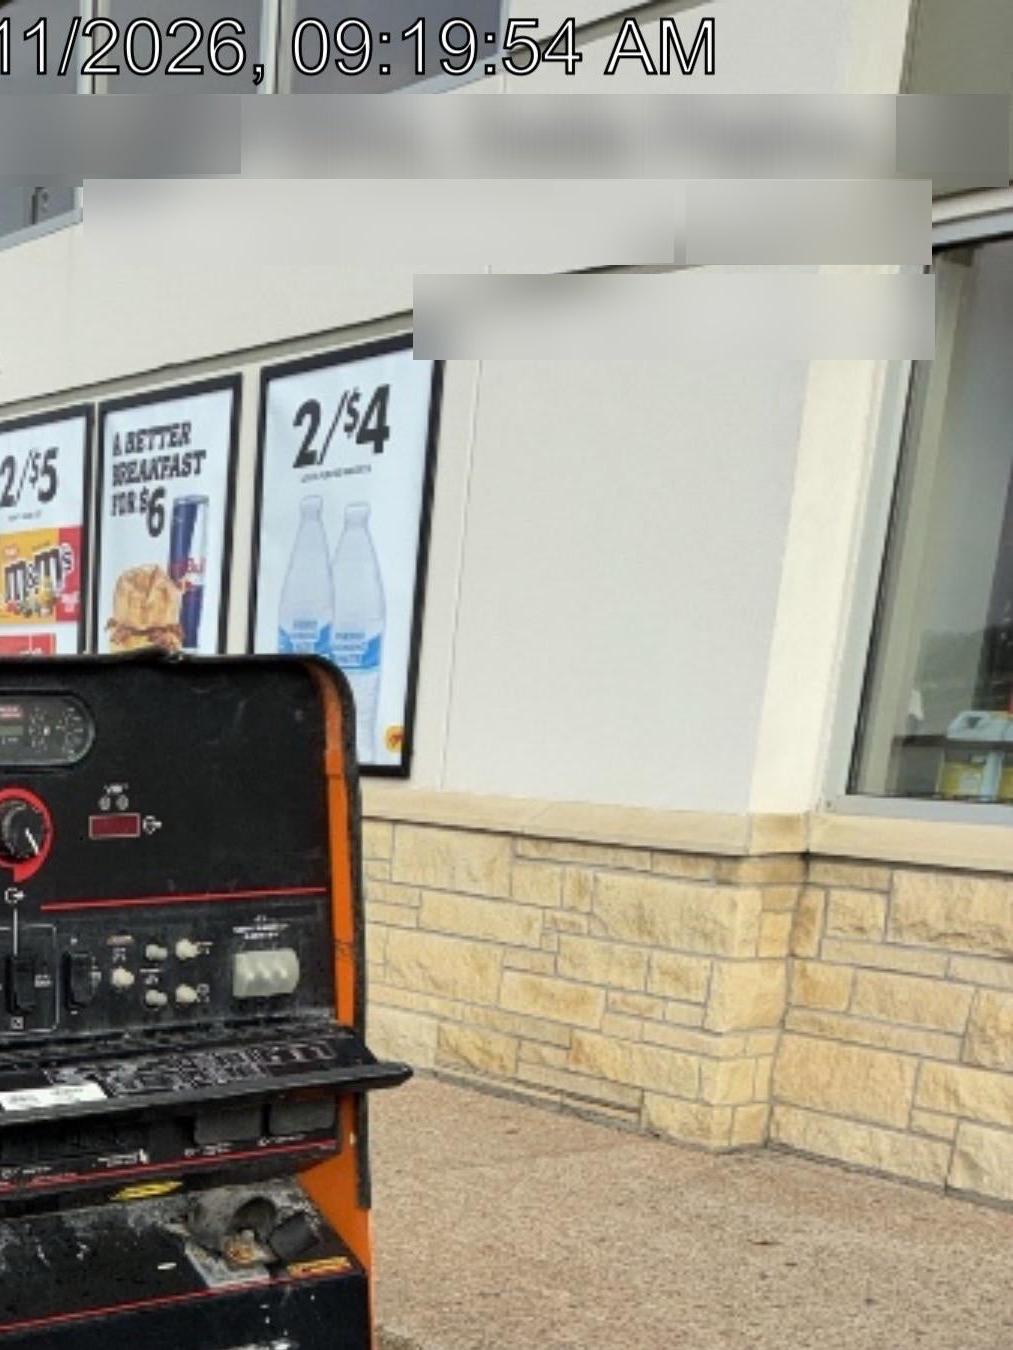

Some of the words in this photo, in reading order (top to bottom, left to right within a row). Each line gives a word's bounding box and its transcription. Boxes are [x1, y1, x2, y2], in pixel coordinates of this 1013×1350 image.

[112, 431, 122, 456] A
[124, 421, 192, 454] BETTER
[292, 383, 390, 469] 2/$4
[112, 450, 207, 486] BREAKFAST
[111, 491, 136, 517] FOR
[139, 486, 166, 538] $6
